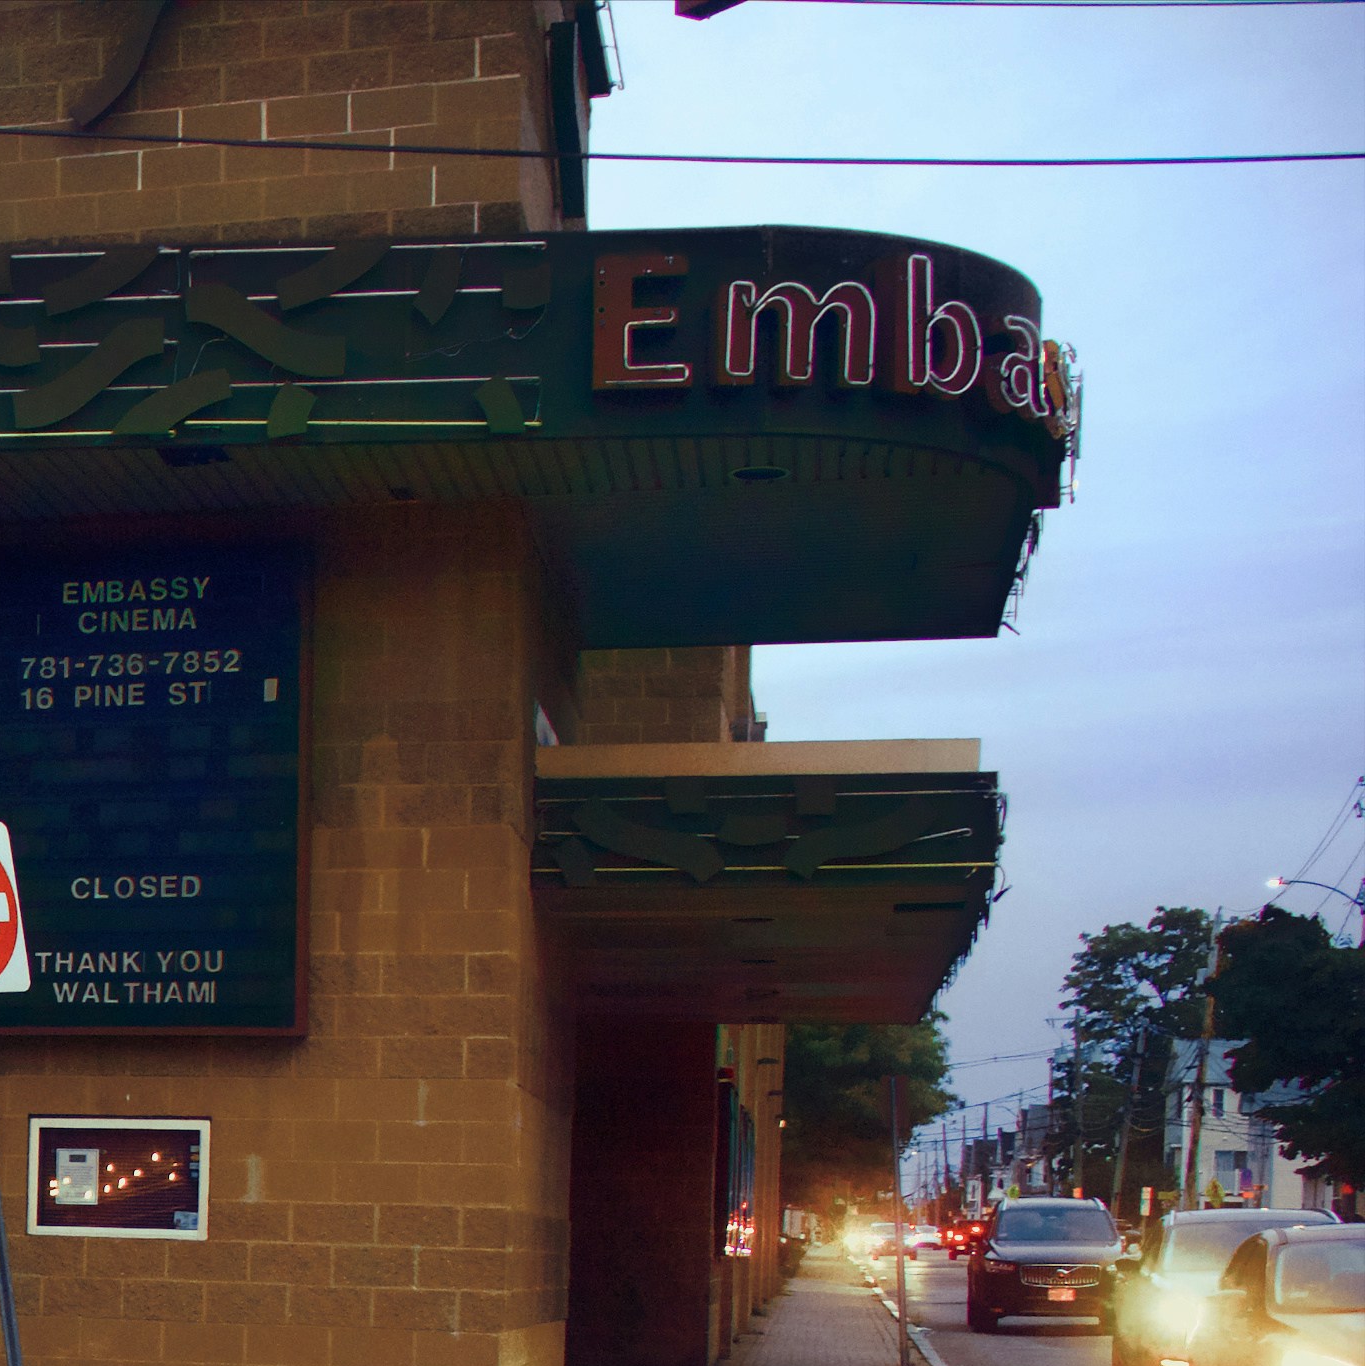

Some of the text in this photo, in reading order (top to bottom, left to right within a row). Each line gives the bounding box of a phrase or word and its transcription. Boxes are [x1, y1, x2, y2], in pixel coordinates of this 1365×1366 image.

[63, 577, 210, 604] EMBASSY
[78, 608, 198, 634] CINEMA
[21, 650, 241, 679] 781-736-7852
[21, 681, 207, 710] 16 PINE ST
[71, 875, 202, 899] CLOSED
[35, 950, 224, 974] THANK YOU
[52, 980, 213, 1004] WALTHAM
